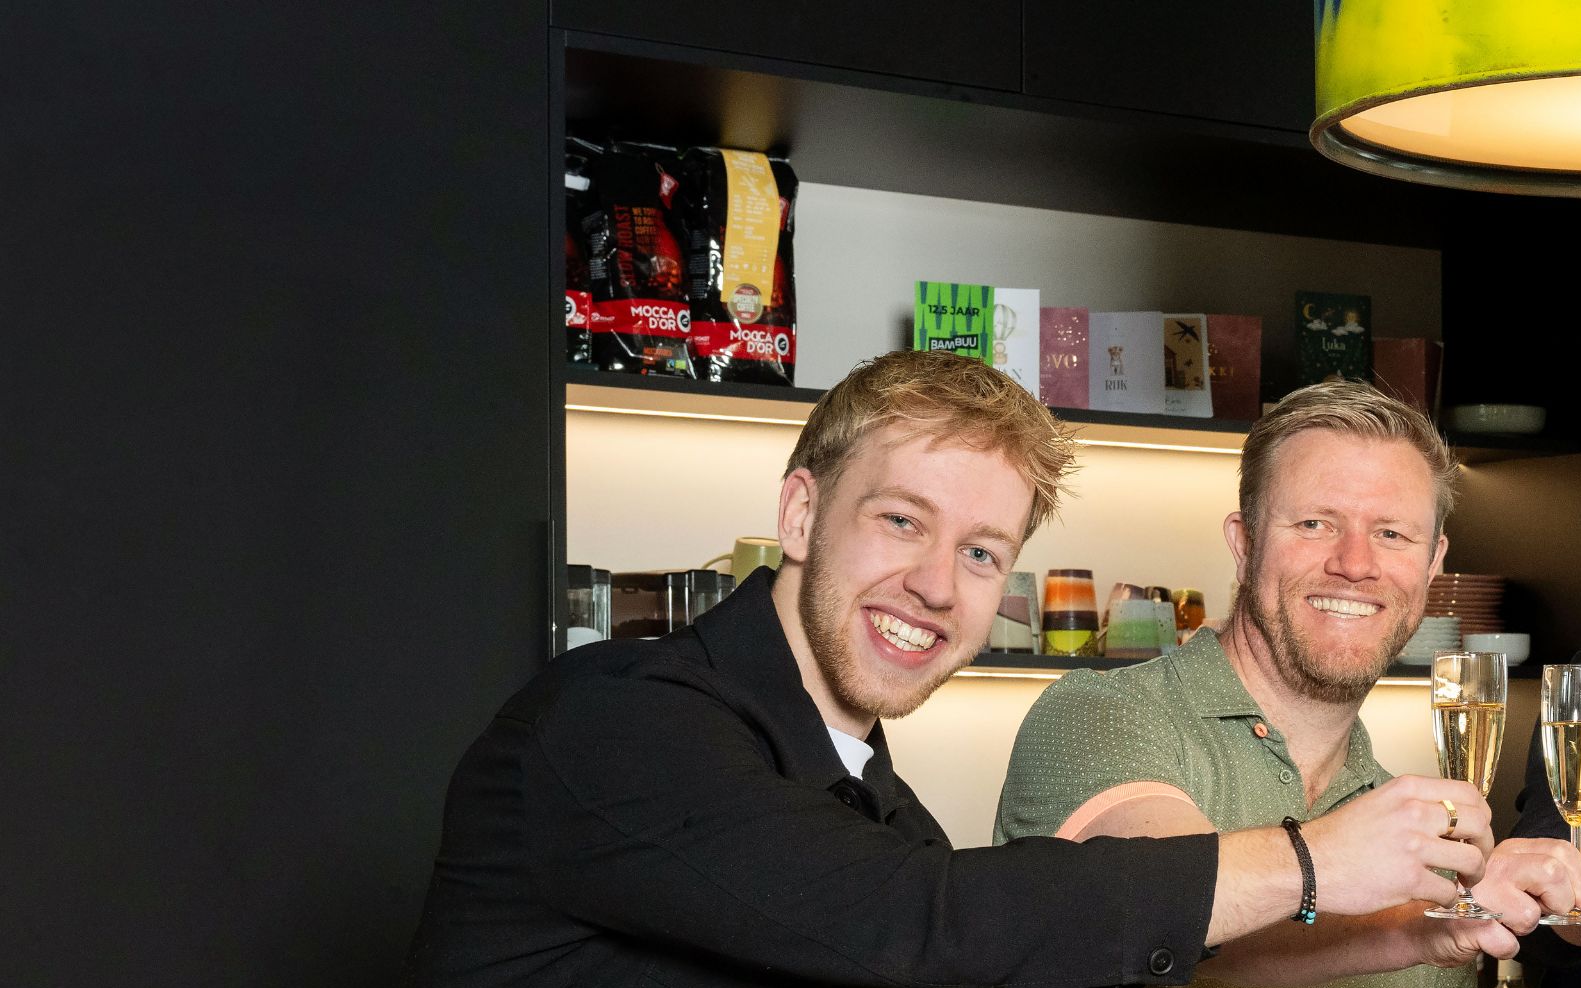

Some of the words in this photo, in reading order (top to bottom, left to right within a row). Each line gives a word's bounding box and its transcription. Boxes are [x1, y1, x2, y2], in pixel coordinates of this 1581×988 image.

[630, 305, 676, 319] MOCCA
[950, 306, 980, 317] JAAR
[649, 317, 677, 331] D'OR
[730, 330, 773, 343] MOCCA
[747, 340, 774, 354] D'OR
[930, 337, 977, 350] BAMBUU
